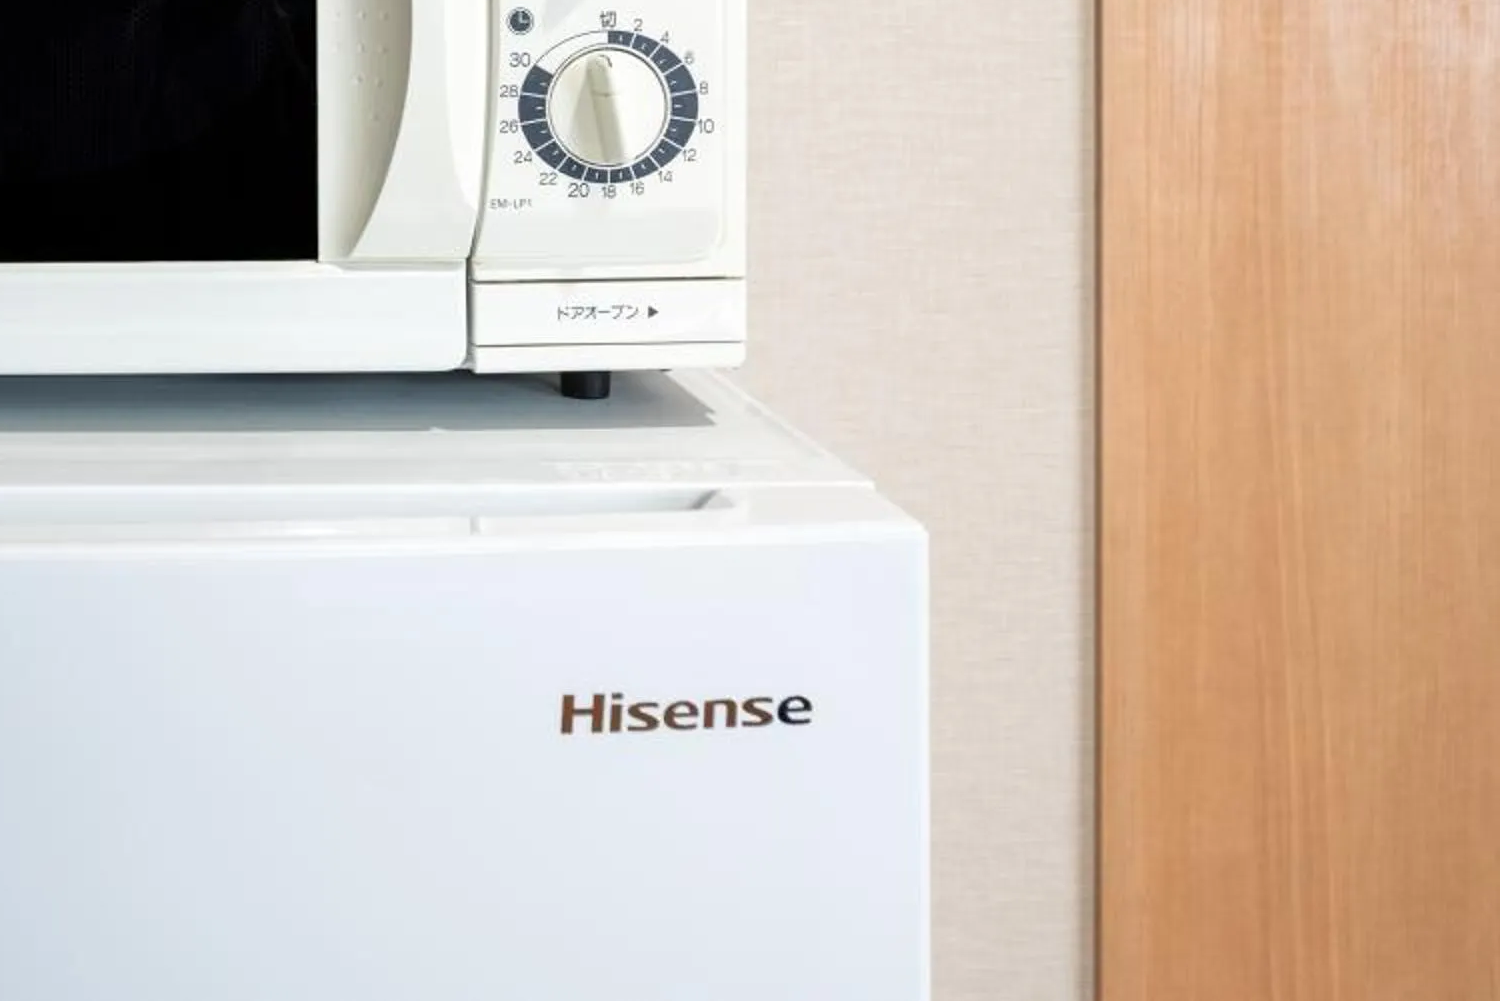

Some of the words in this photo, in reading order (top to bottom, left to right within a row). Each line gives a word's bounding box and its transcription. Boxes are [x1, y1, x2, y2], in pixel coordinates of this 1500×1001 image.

[633, 19, 643, 31] 2
[660, 31, 669, 43] 4
[509, 52, 531, 68] 30
[684, 52, 694, 65] 6
[499, 85, 519, 98] 28
[699, 82, 709, 95] 8
[499, 120, 519, 133] 26
[698, 119, 715, 134] 10
[513, 150, 533, 163] 24
[682, 149, 697, 162] 12
[539, 173, 558, 186] 22
[658, 170, 673, 183] 14
[567, 183, 590, 198] 20
[601, 186, 617, 199] 18
[630, 182, 645, 195] 16
[557, 305, 639, 320] ドアオープン
[560, 692, 813, 735] Hisense
